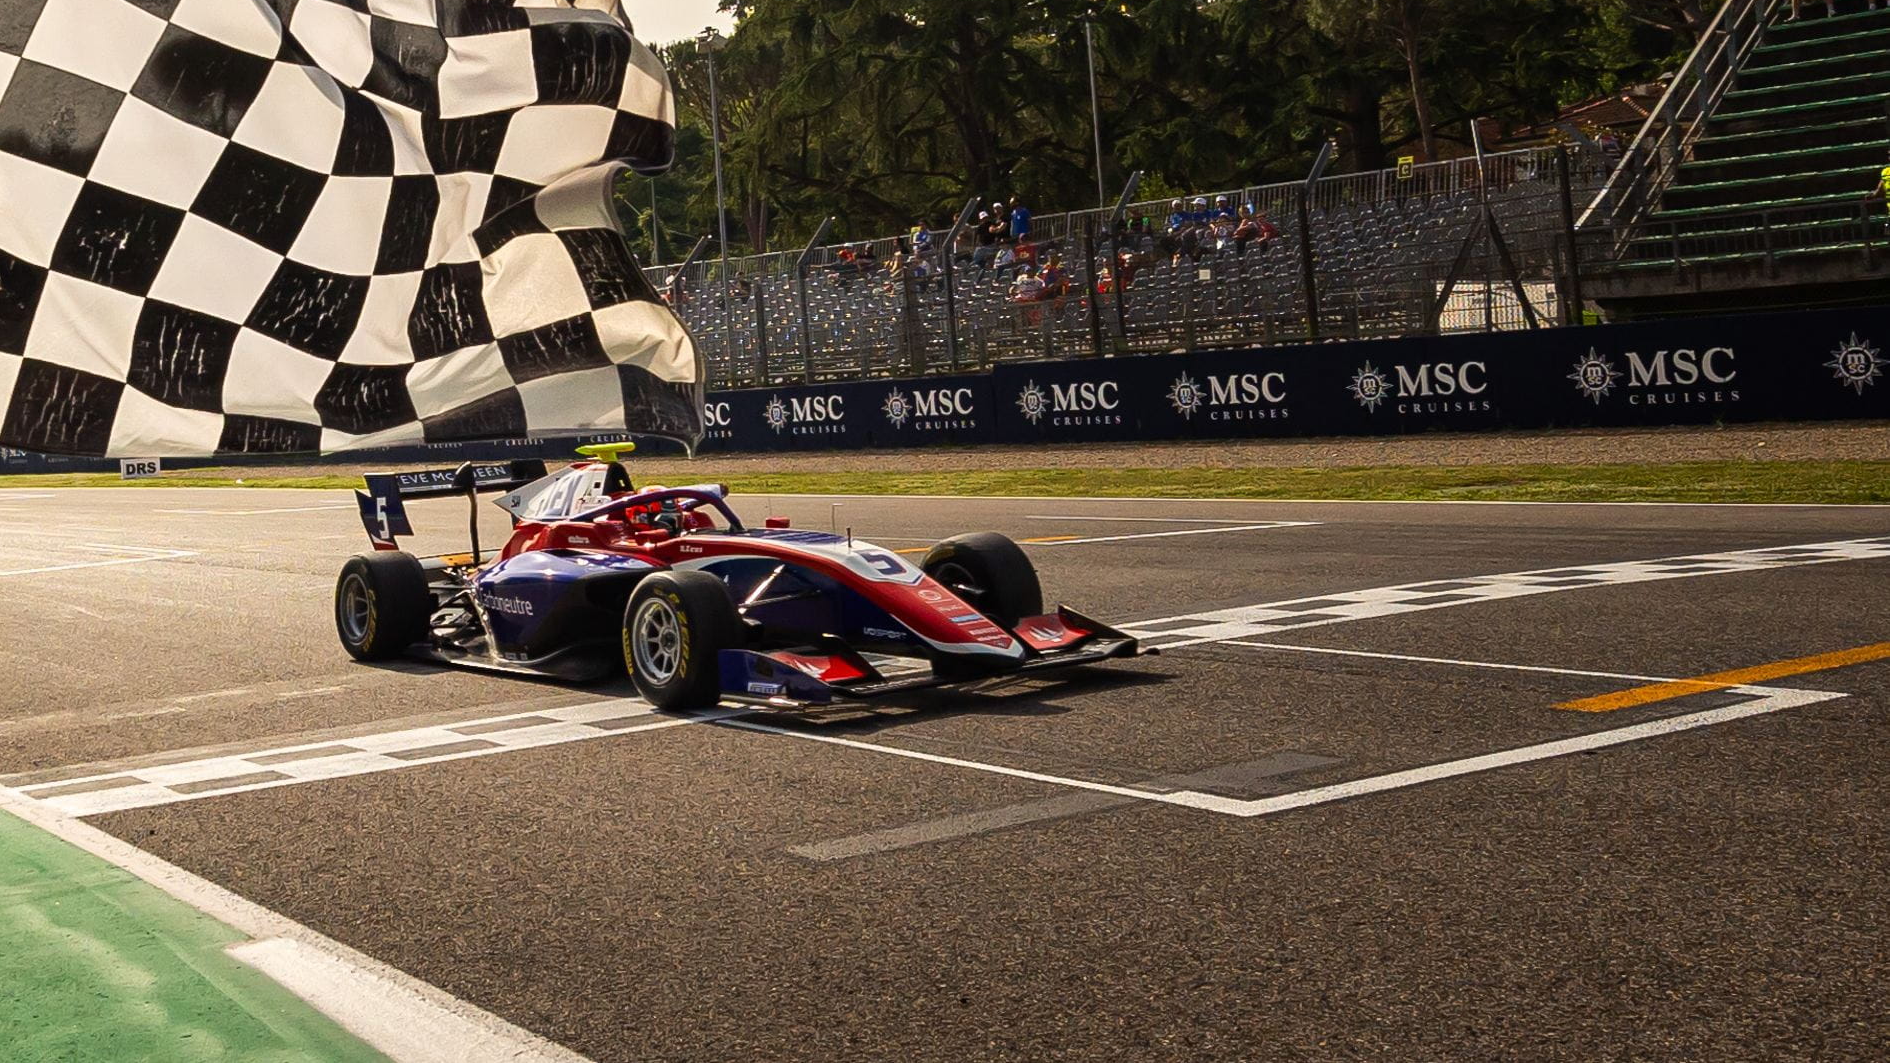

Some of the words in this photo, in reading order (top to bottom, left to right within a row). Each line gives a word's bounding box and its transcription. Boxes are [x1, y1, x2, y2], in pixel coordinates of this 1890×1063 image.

[1624, 346, 1737, 387] MSC
[1208, 372, 1286, 406] MSC
[1394, 361, 1487, 397] MSC
[914, 388, 974, 417] MSC
[1051, 381, 1119, 411] MSC
[1397, 400, 1491, 414] CRUISES
[1629, 391, 1740, 405] CRUISES
[704, 402, 730, 426] SC
[791, 395, 844, 422] MSC
[1053, 415, 1121, 426] CRUISES
[1210, 408, 1289, 421] CRUISES
[793, 424, 846, 435] CRUISES
[916, 420, 976, 431] CRUISES
[126, 461, 157, 476] DRS
[396, 472, 429, 484] EVE
[376, 496, 390, 539] 5
[860, 551, 907, 576] 5
